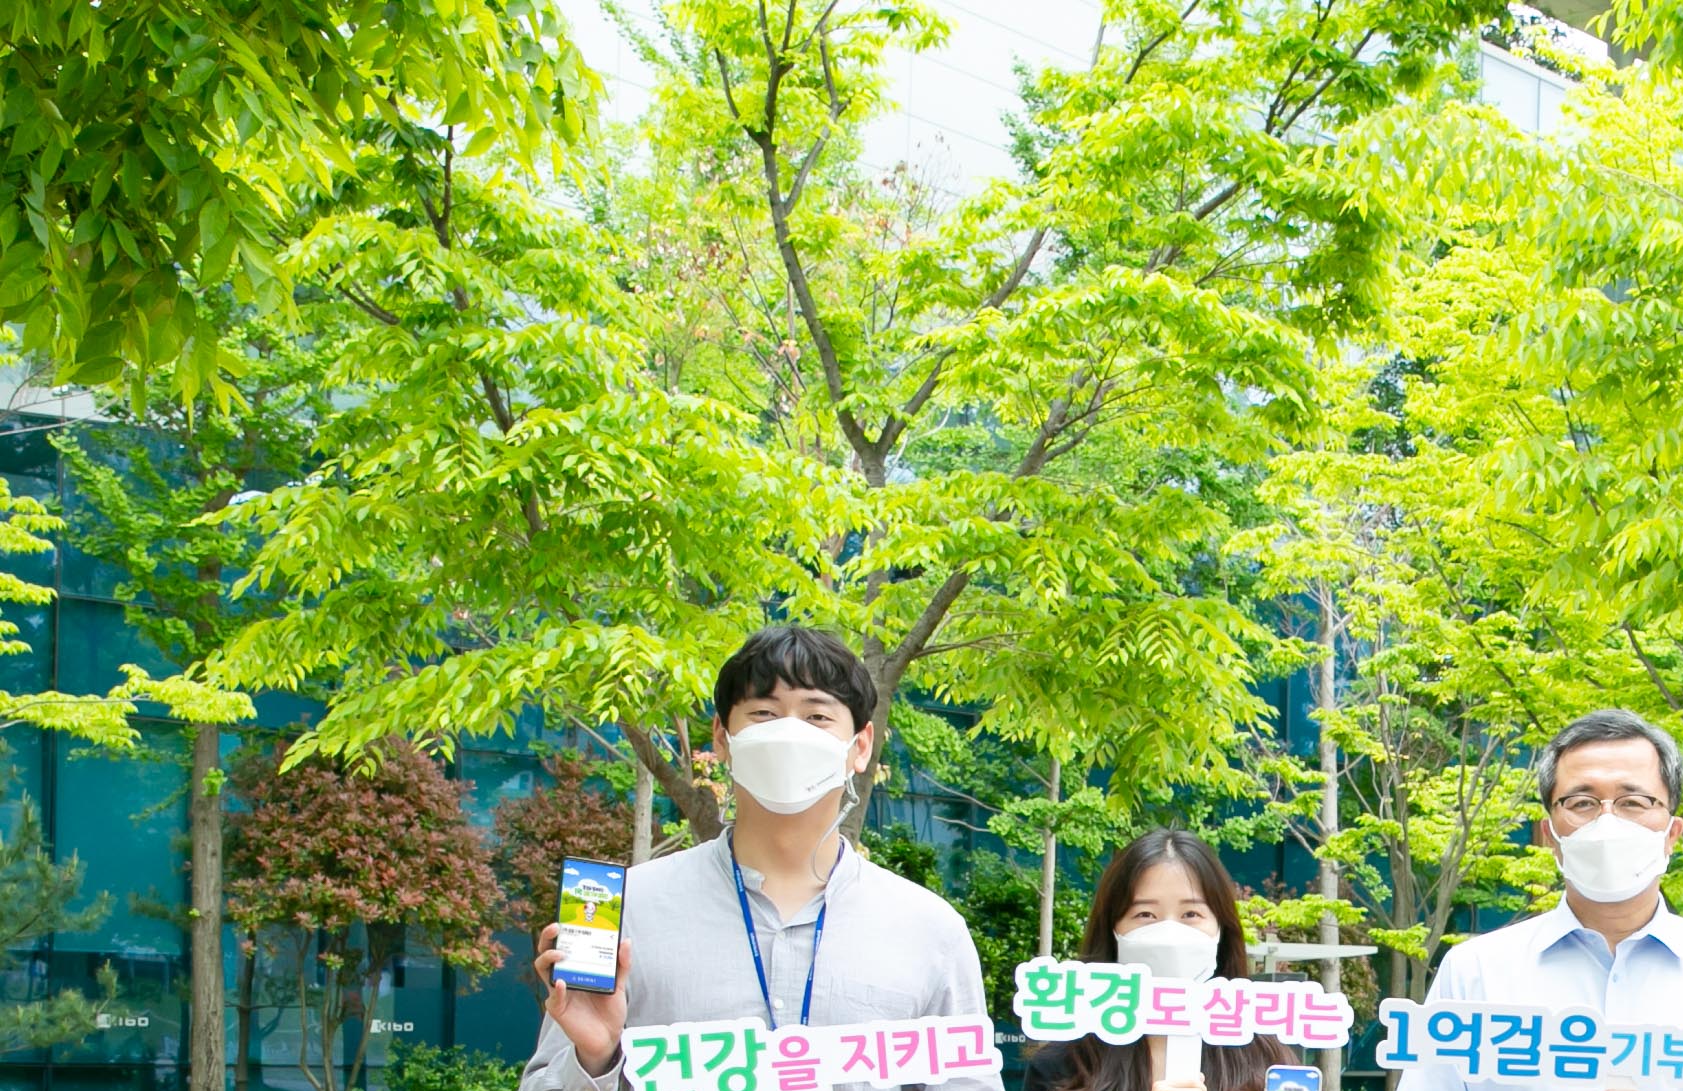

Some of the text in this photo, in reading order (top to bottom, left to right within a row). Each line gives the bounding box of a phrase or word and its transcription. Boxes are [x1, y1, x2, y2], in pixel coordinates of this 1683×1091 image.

[1022, 965, 1351, 1041] 환경도 살리는
[840, 1025, 993, 1080] 지키고
